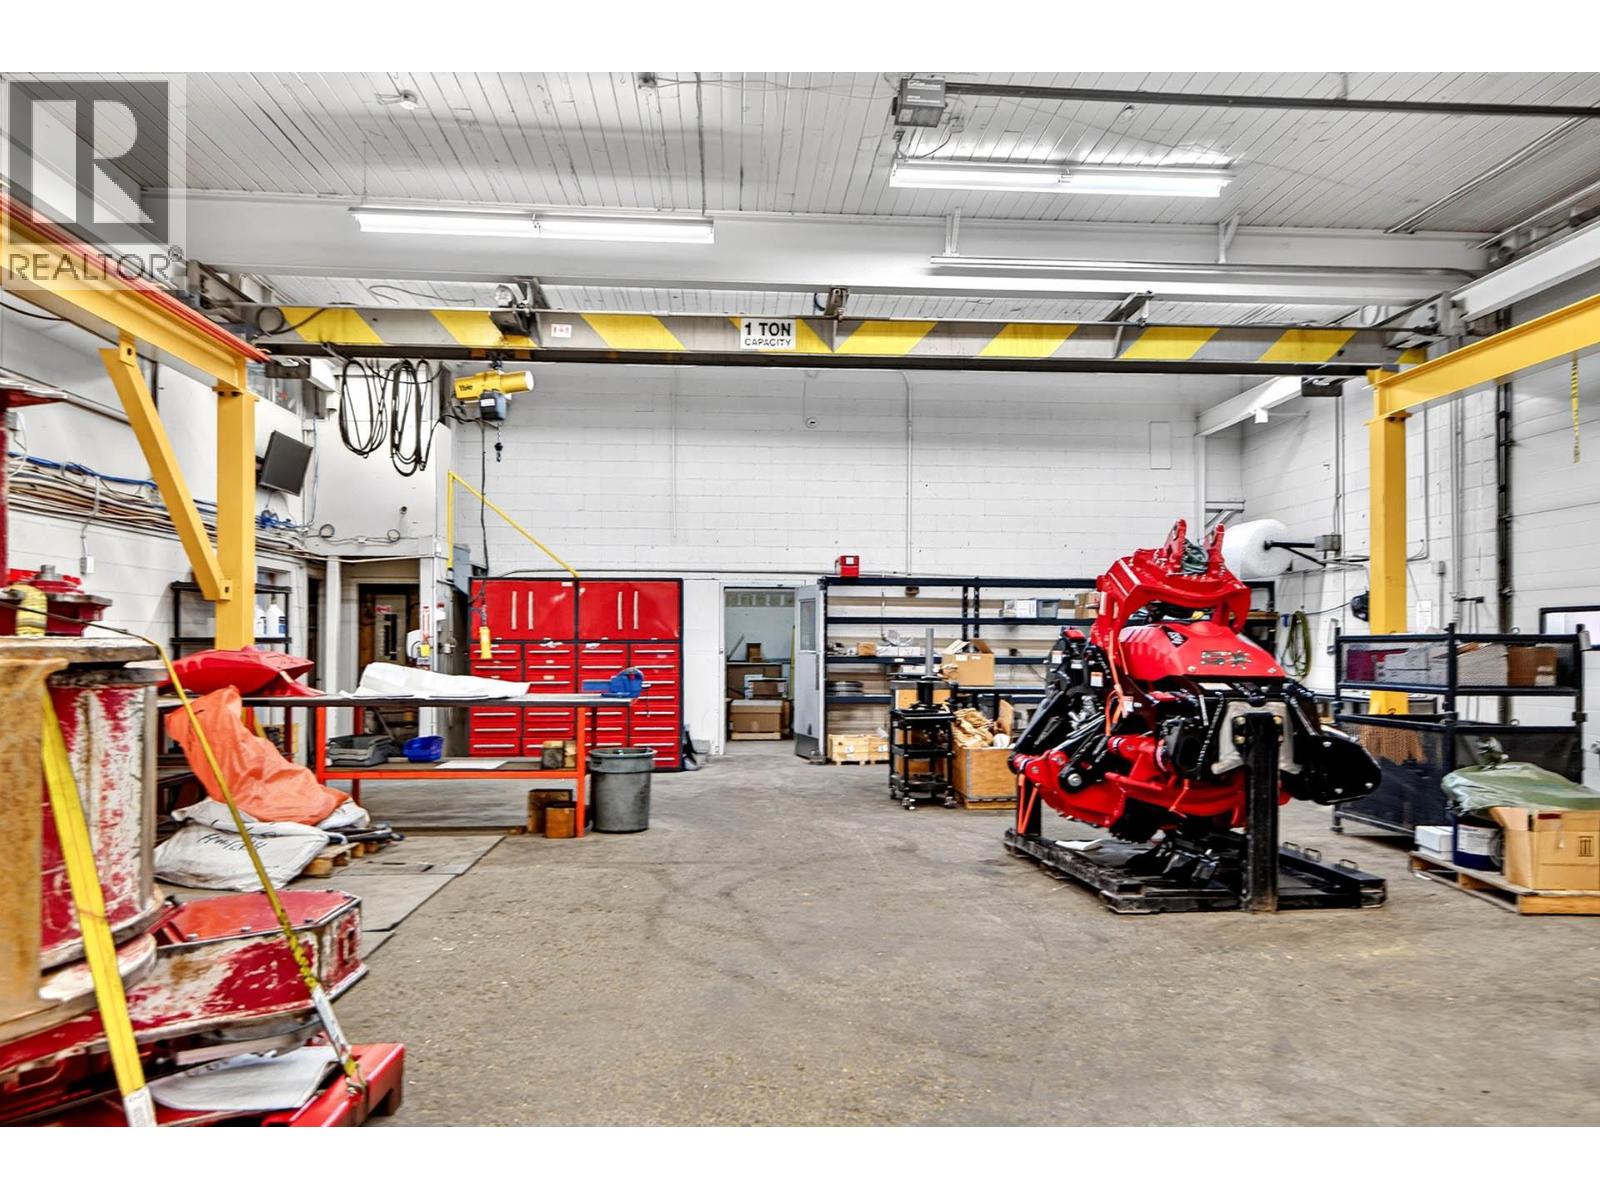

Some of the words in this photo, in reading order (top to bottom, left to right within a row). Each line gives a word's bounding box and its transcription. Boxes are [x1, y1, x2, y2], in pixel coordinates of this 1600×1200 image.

[745, 321, 751, 336] 1
[758, 321, 791, 336] TON
[744, 338, 792, 347] CAPACITY
